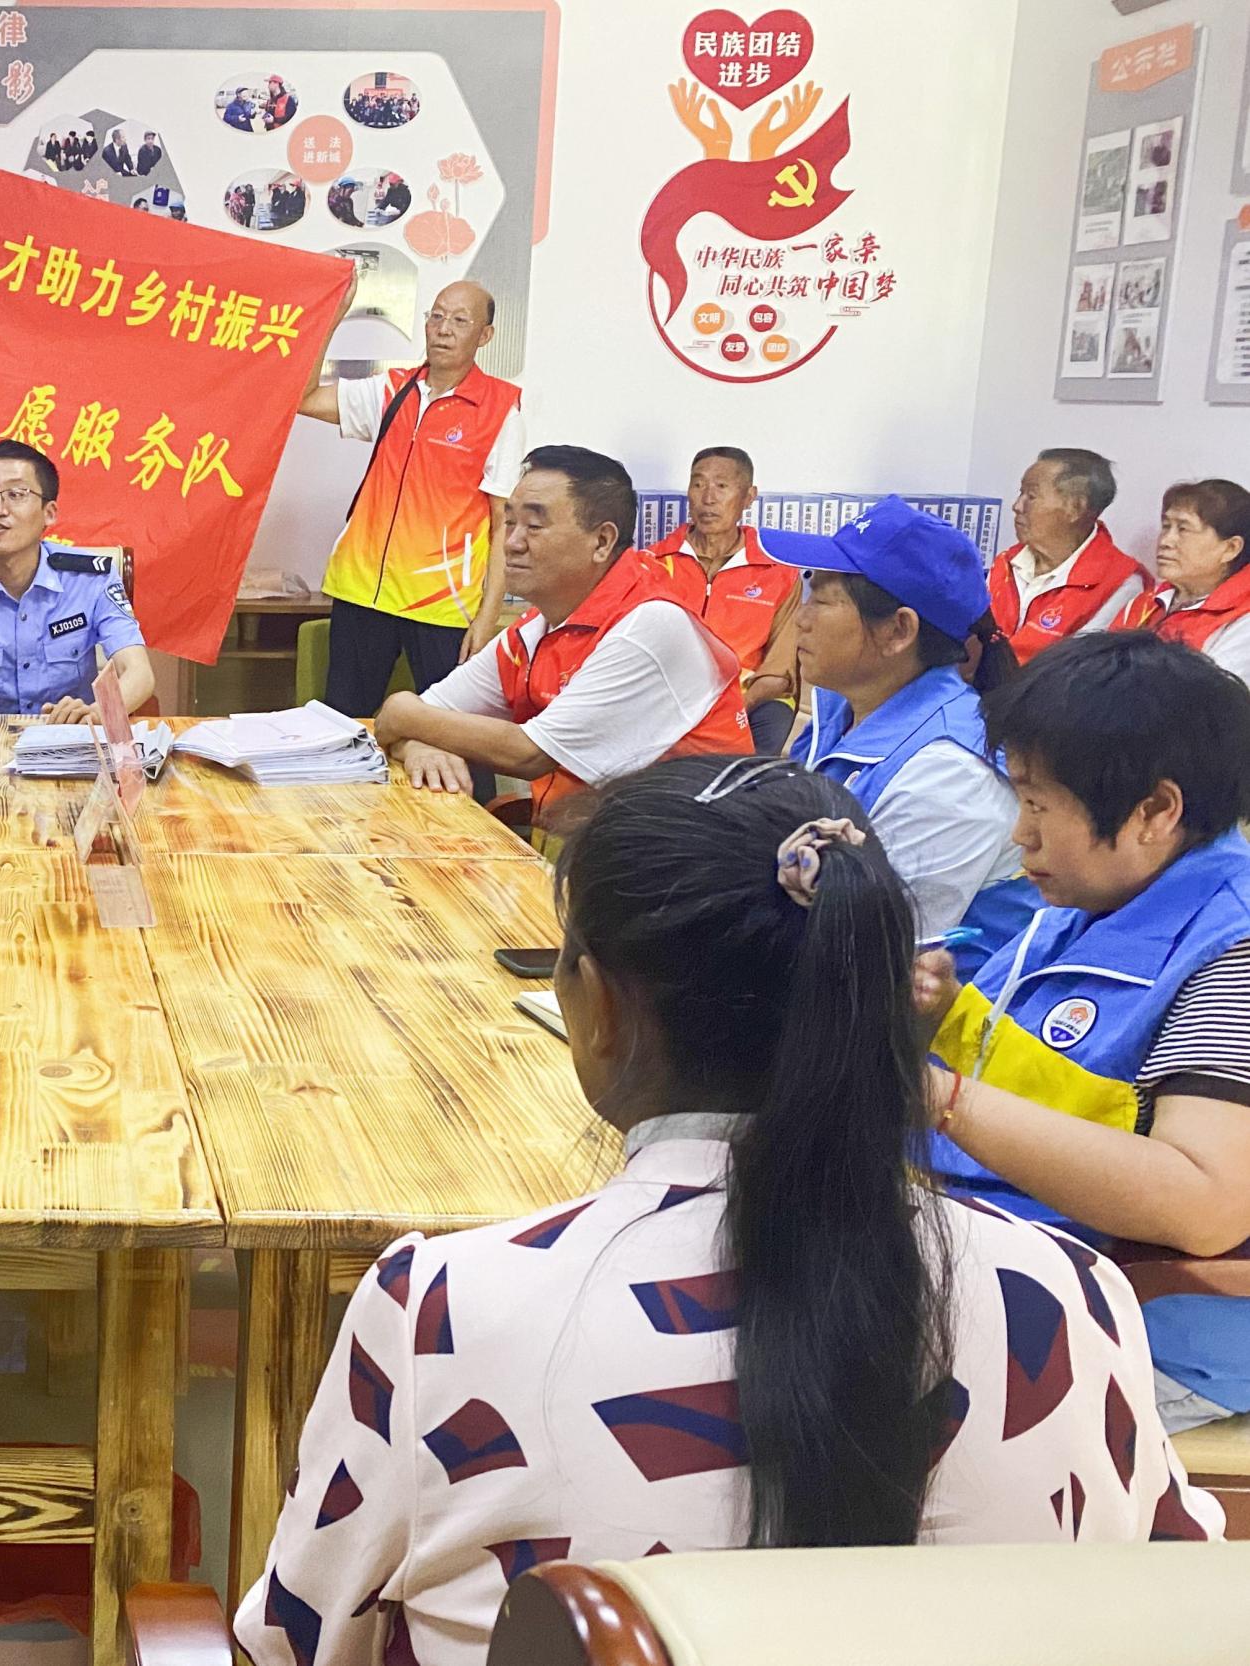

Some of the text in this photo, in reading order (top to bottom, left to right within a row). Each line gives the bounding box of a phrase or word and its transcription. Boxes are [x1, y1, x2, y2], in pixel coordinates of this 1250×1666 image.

[693, 31, 801, 57] 民族团结
[717, 62, 771, 88] 进步
[696, 232, 881, 270] 中华民族一家亲
[718, 269, 898, 303] 同心共筑中国梦
[697, 312, 721, 325] 文明
[753, 312, 774, 325] 包容
[724, 341, 747, 354] 友爱
[52, 617, 84, 634] XJ0109
